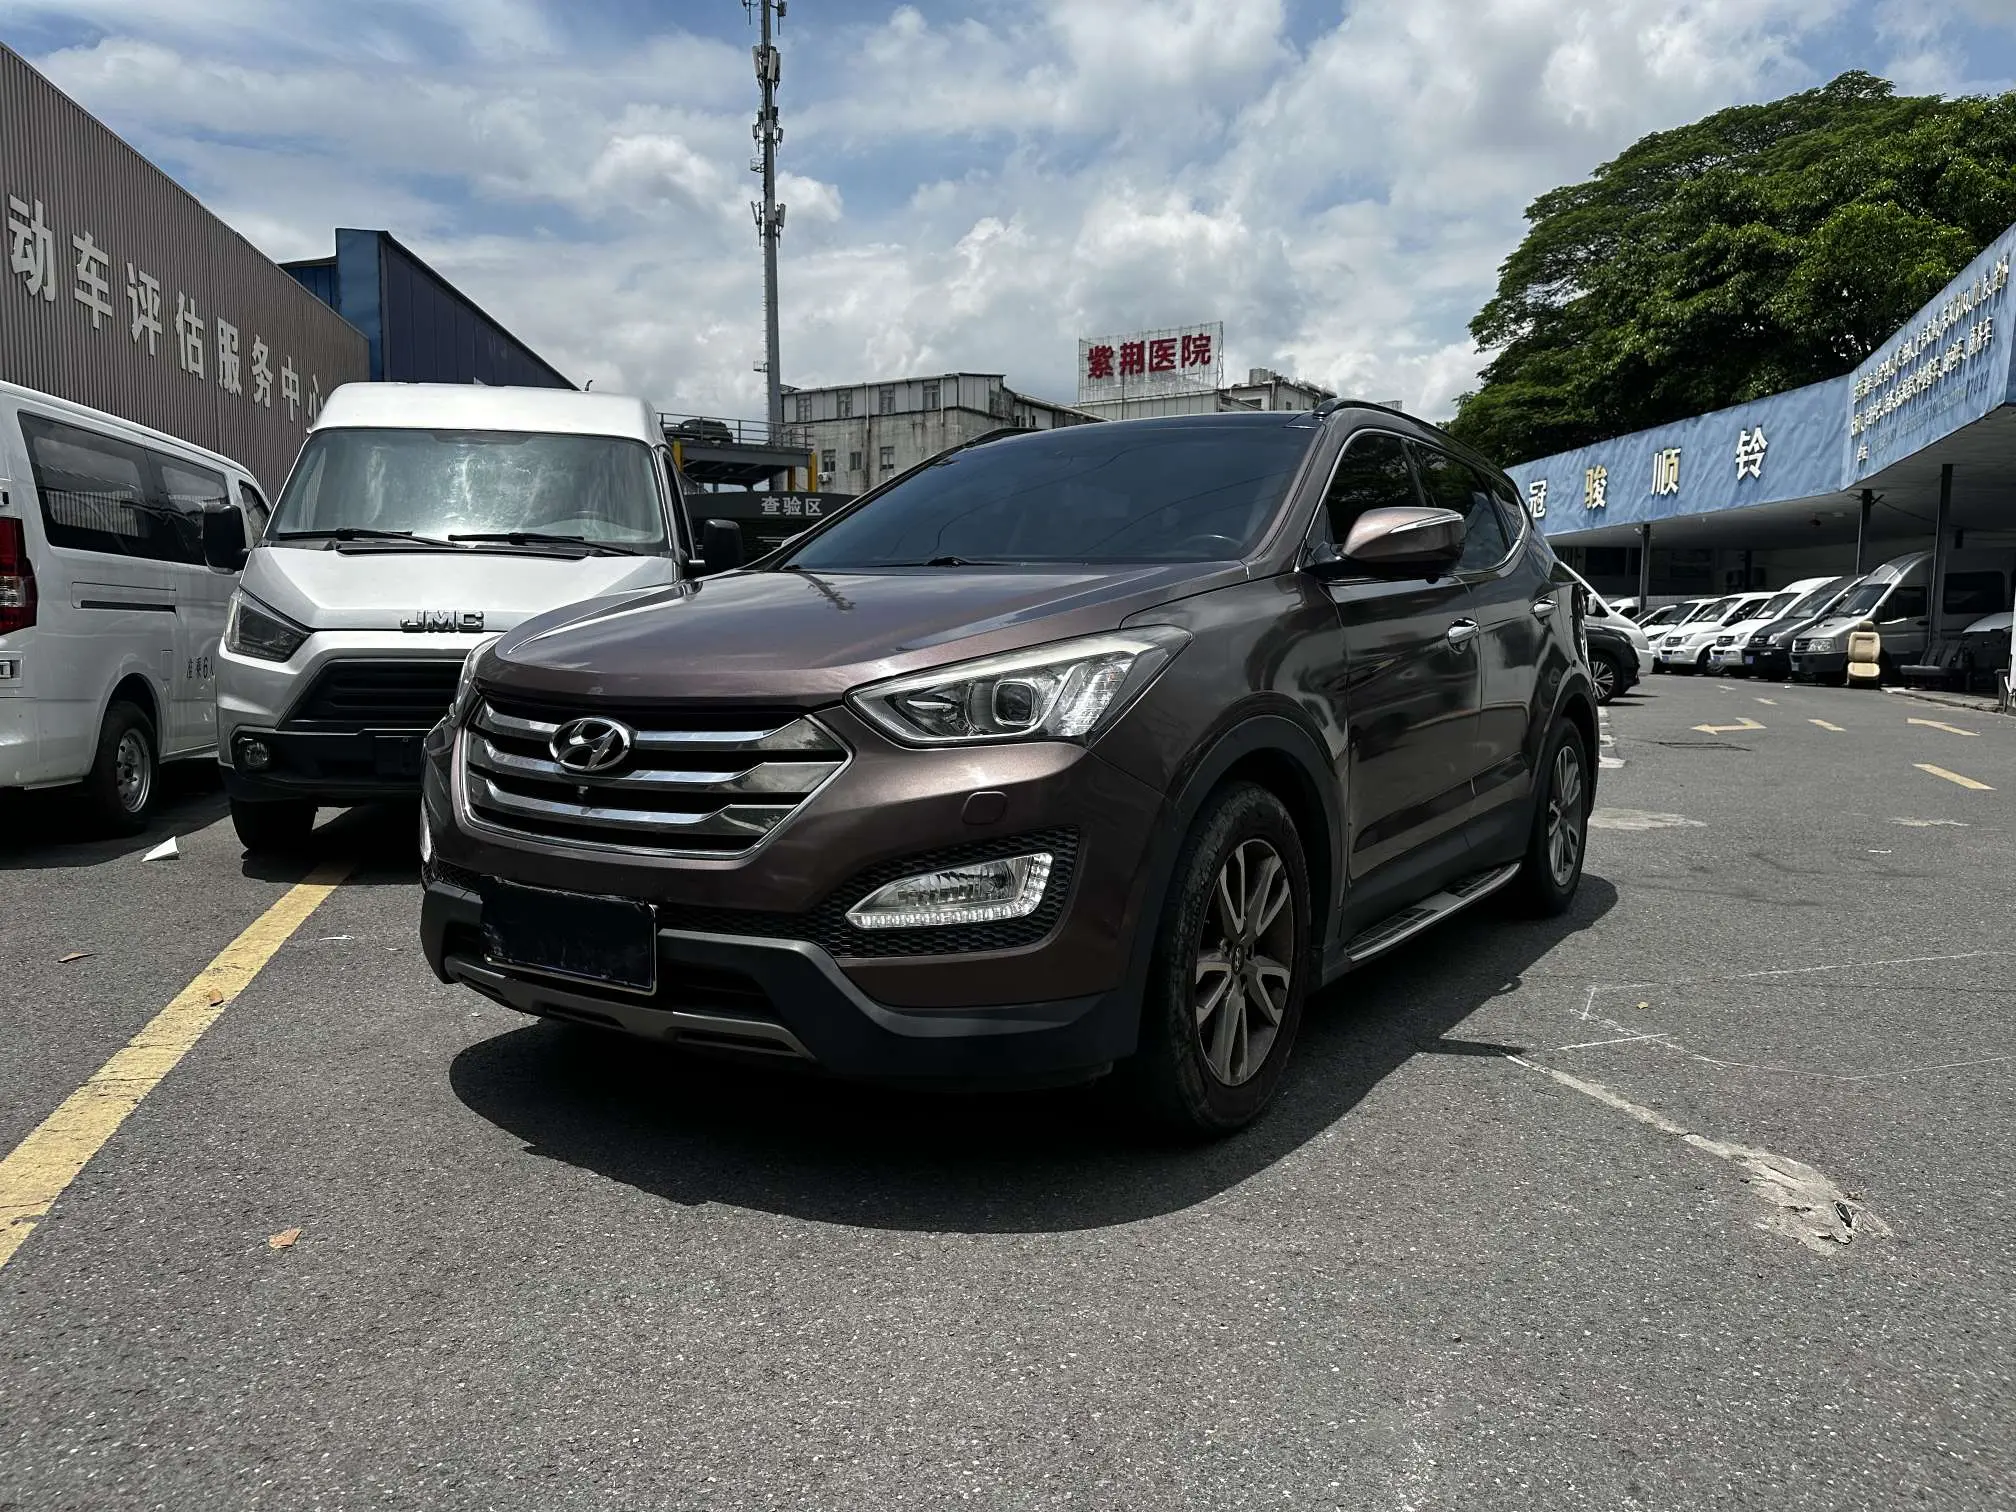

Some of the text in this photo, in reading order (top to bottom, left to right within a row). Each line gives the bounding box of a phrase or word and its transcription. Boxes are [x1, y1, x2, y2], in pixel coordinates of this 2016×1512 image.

[1087, 333, 1212, 380] 紫荆医院
[761, 495, 823, 516] 查验区
[400, 610, 484, 633] JMC
